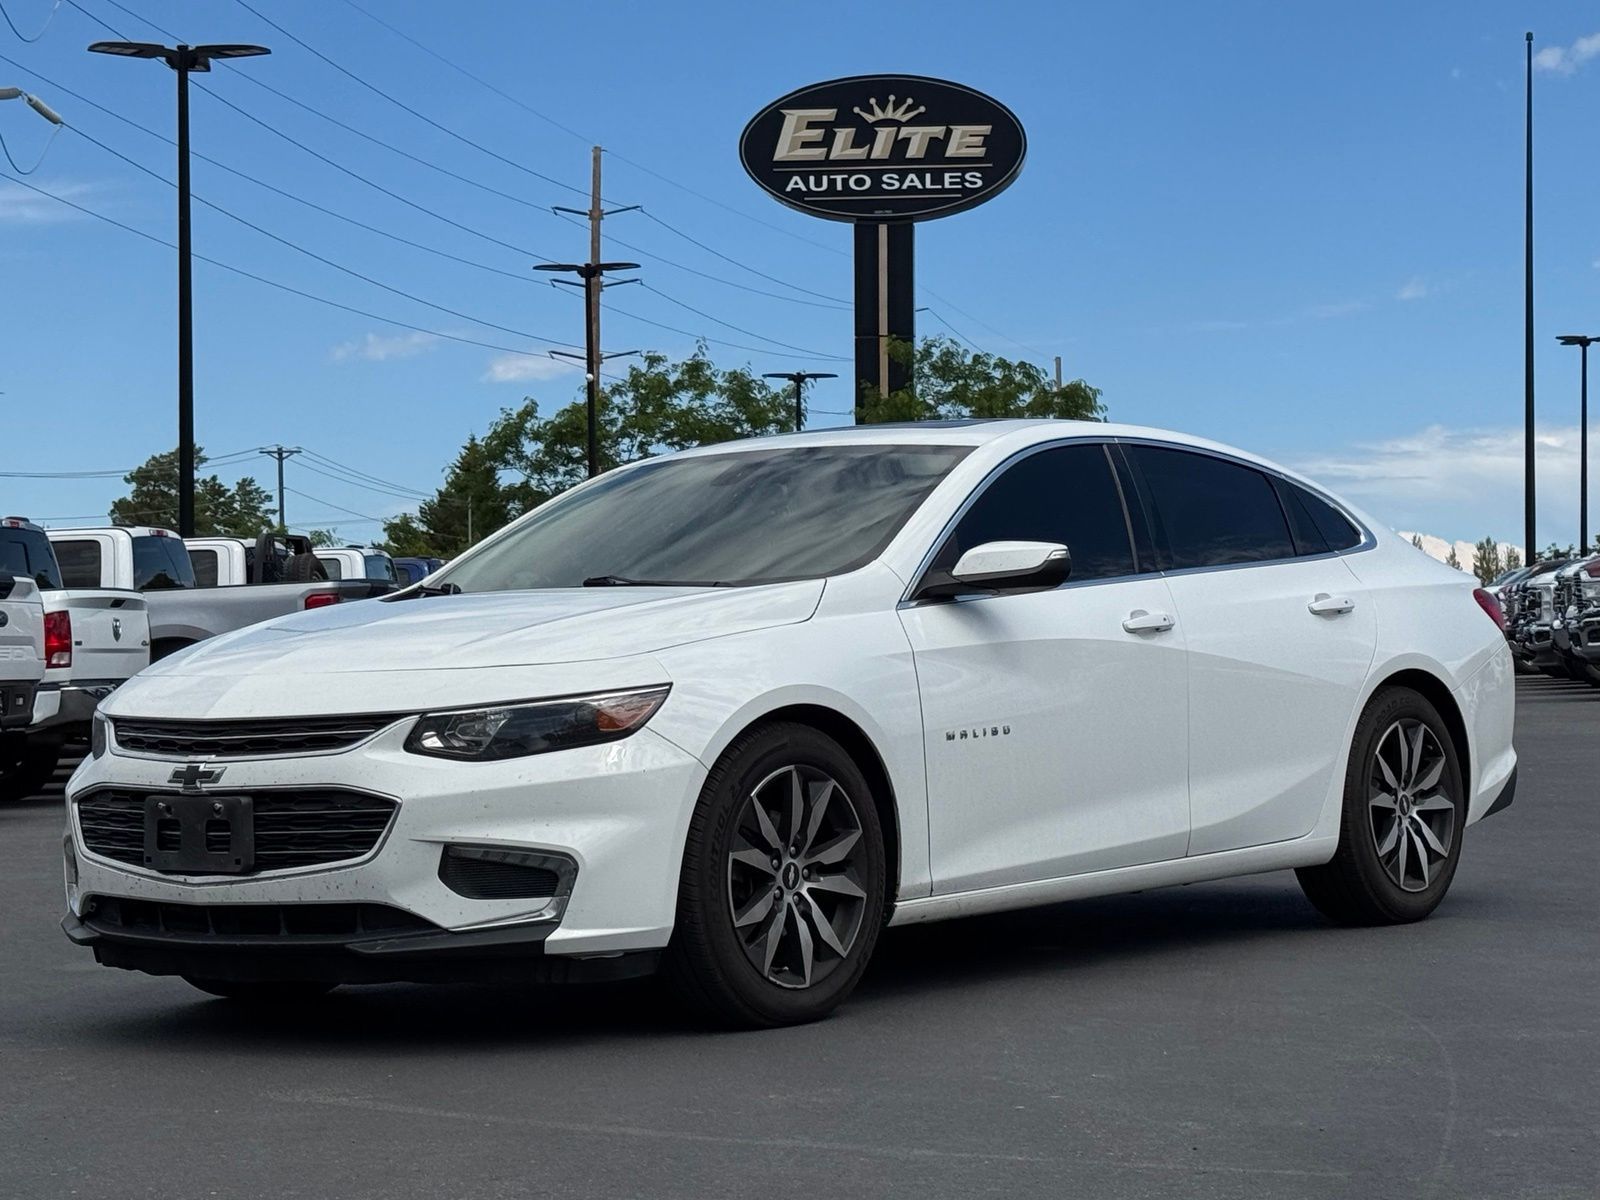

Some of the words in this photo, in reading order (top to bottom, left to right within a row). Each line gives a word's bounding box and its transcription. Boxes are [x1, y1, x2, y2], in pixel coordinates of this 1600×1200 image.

[773, 108, 993, 161] ELITE
[785, 174, 872, 192] AUTO
[881, 172, 983, 190] SALES
[945, 725, 1011, 741] MALIBU
